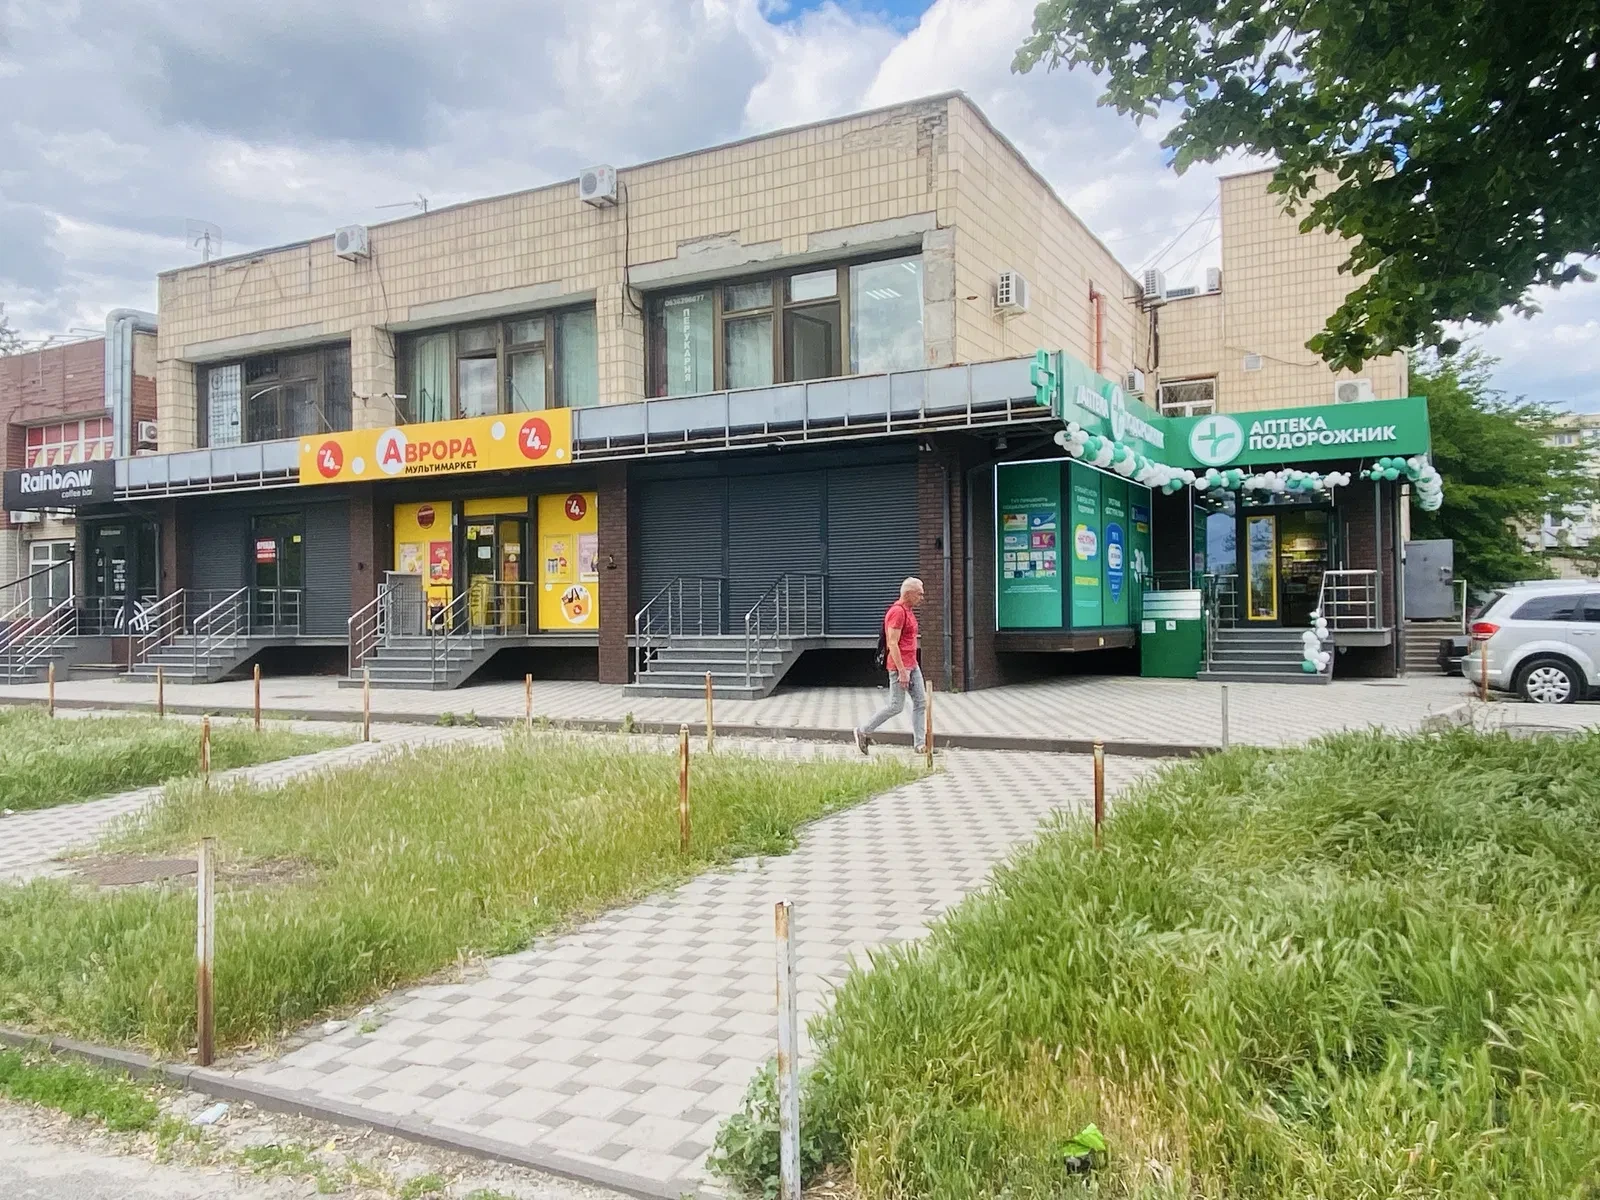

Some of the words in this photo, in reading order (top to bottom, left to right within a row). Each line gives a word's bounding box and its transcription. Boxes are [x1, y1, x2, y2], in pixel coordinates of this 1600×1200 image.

[682, 308, 692, 382] ПЕРУКАРНЯ
[1250, 416, 1327, 435] АПТЕКА
[526, 427, 542, 450] 4
[1249, 425, 1397, 450] ПОДОРОЖНИК
[405, 460, 478, 475] МУЛЬТИМАРКЕТ
[20, 468, 93, 493] Rainbow
[61, 489, 81, 499] coffee
[82, 488, 93, 497] bar
